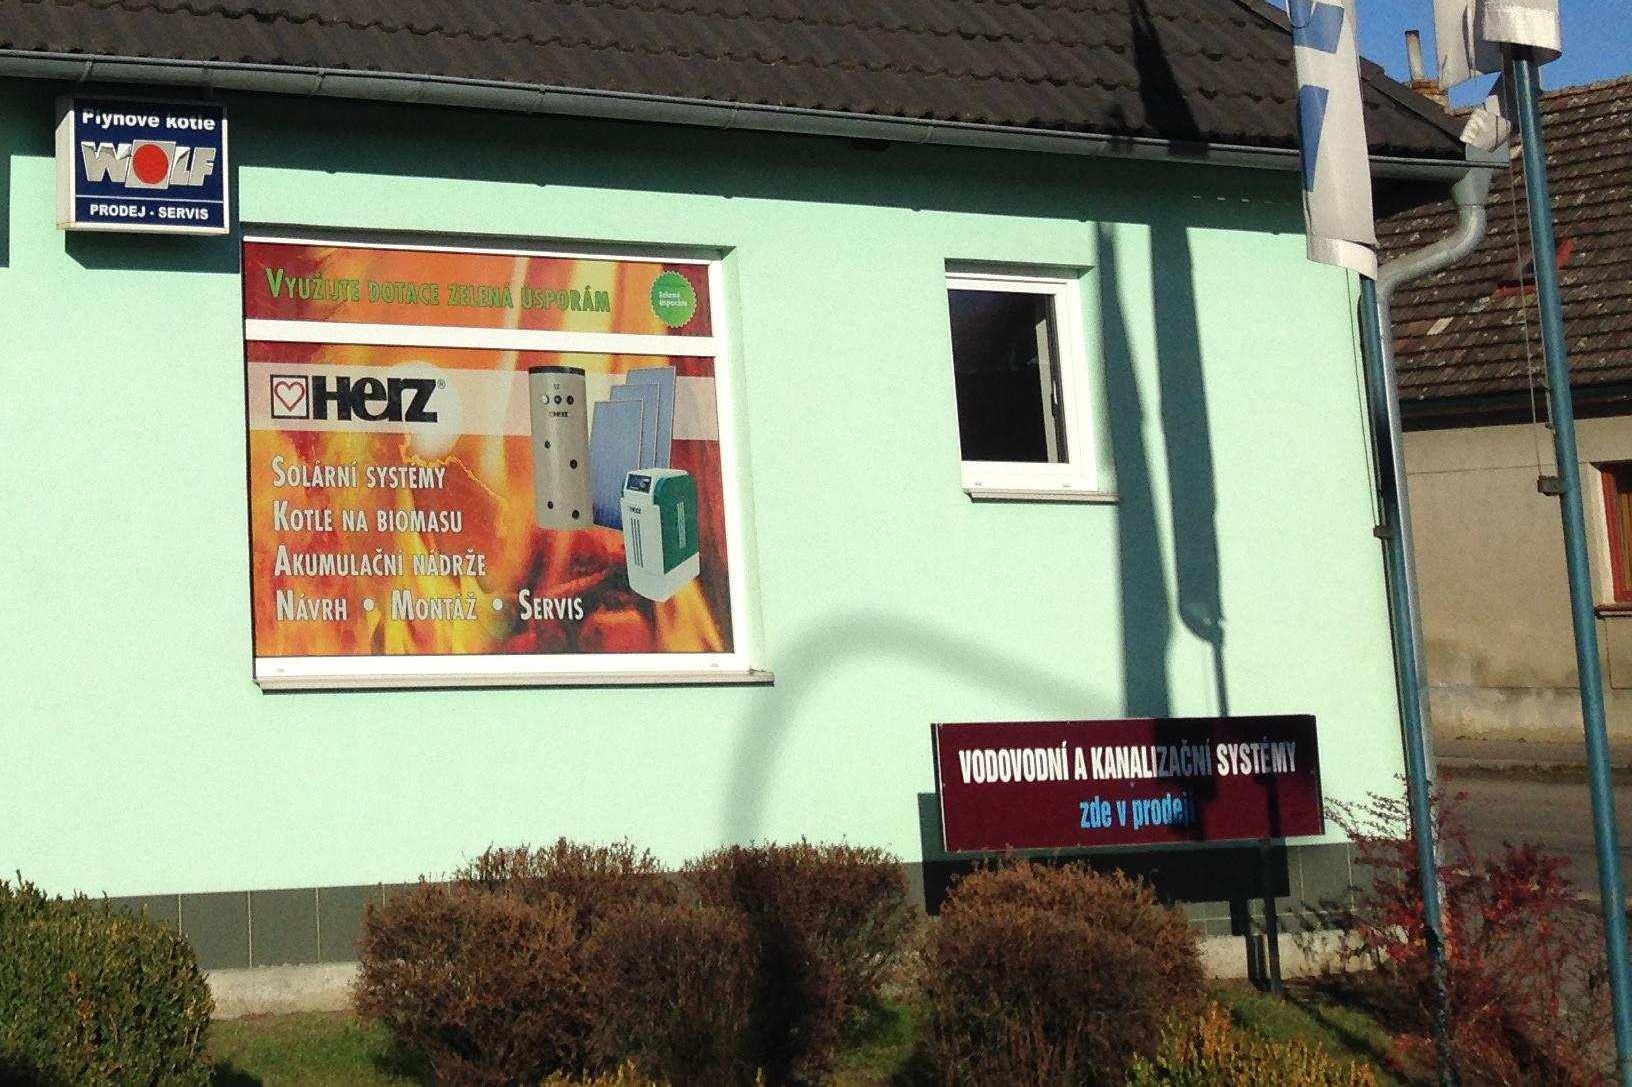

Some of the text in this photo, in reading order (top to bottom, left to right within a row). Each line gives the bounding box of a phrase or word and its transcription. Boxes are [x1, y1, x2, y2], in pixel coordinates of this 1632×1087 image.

[82, 108, 216, 131] Plynové kotle
[80, 139, 217, 190] WOLF
[90, 204, 146, 218] PRODEJ
[158, 207, 209, 220] SERVIS
[368, 280, 440, 306] DOTACE
[447, 282, 514, 309] ZELENÁ
[520, 282, 611, 313] ÚSPORÁM
[272, 456, 447, 490] SOLÁRNÍ SYSTÉMY
[273, 500, 463, 533] KOTLE NA BIOMASU
[274, 545, 487, 578] AKUMULAČNÍ NÁDRŽE
[276, 588, 584, 621] NÁVRH MONTÁŽ SERVIS
[958, 736, 1296, 784] VODOVODNÍ A KANALIZAČNÍ SYSTÉMY
[1079, 795, 1112, 829] zde
[1117, 800, 1127, 827] v
